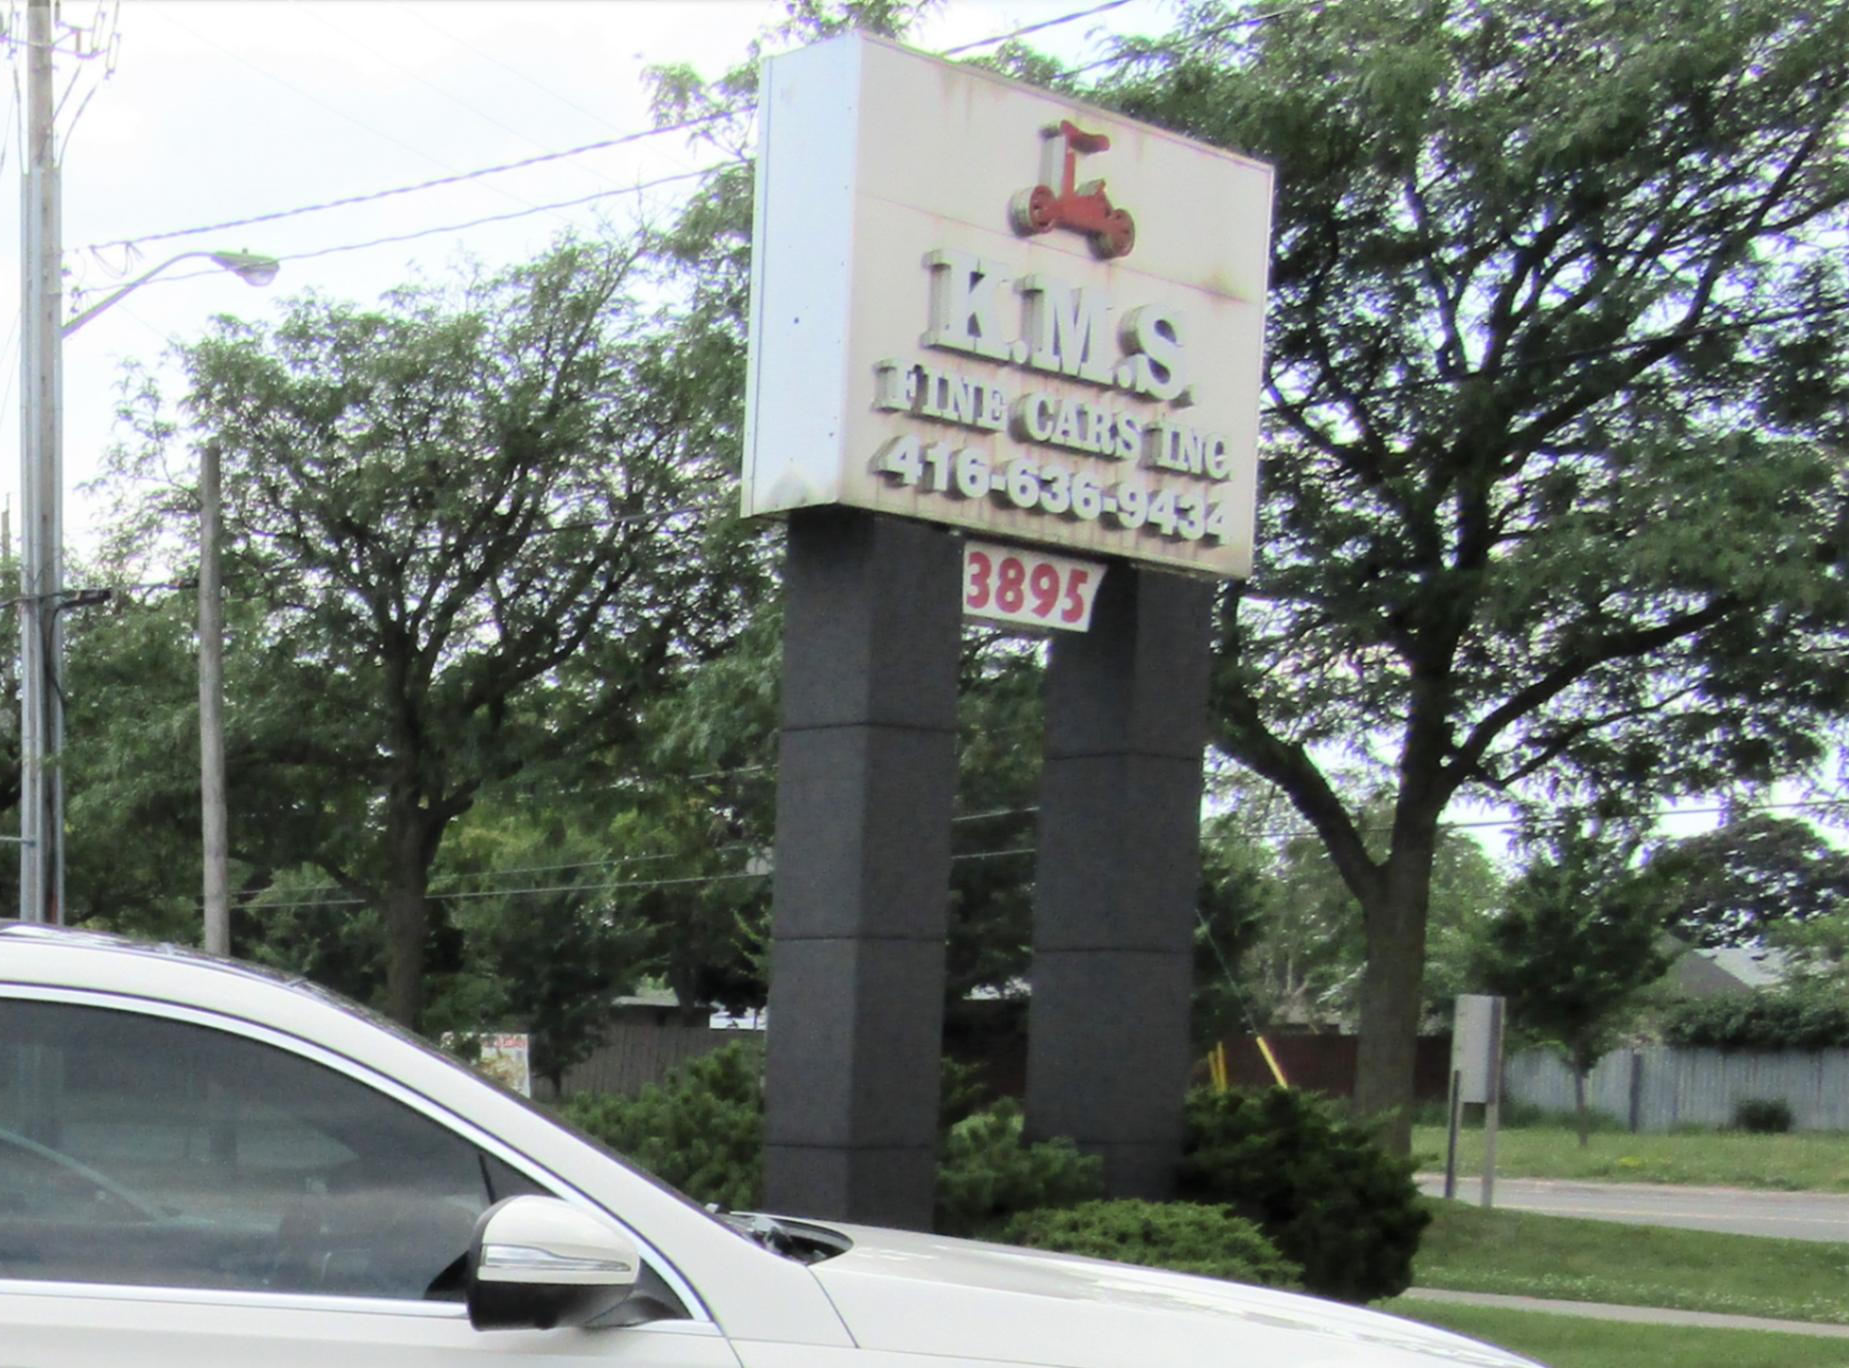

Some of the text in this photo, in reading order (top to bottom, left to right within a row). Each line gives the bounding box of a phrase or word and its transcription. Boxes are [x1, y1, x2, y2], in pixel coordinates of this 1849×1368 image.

[872, 358, 1009, 432] FINE
[1010, 391, 1144, 462] CARS
[870, 434, 1228, 547] 416-636-9434
[966, 551, 1089, 623] 3895
